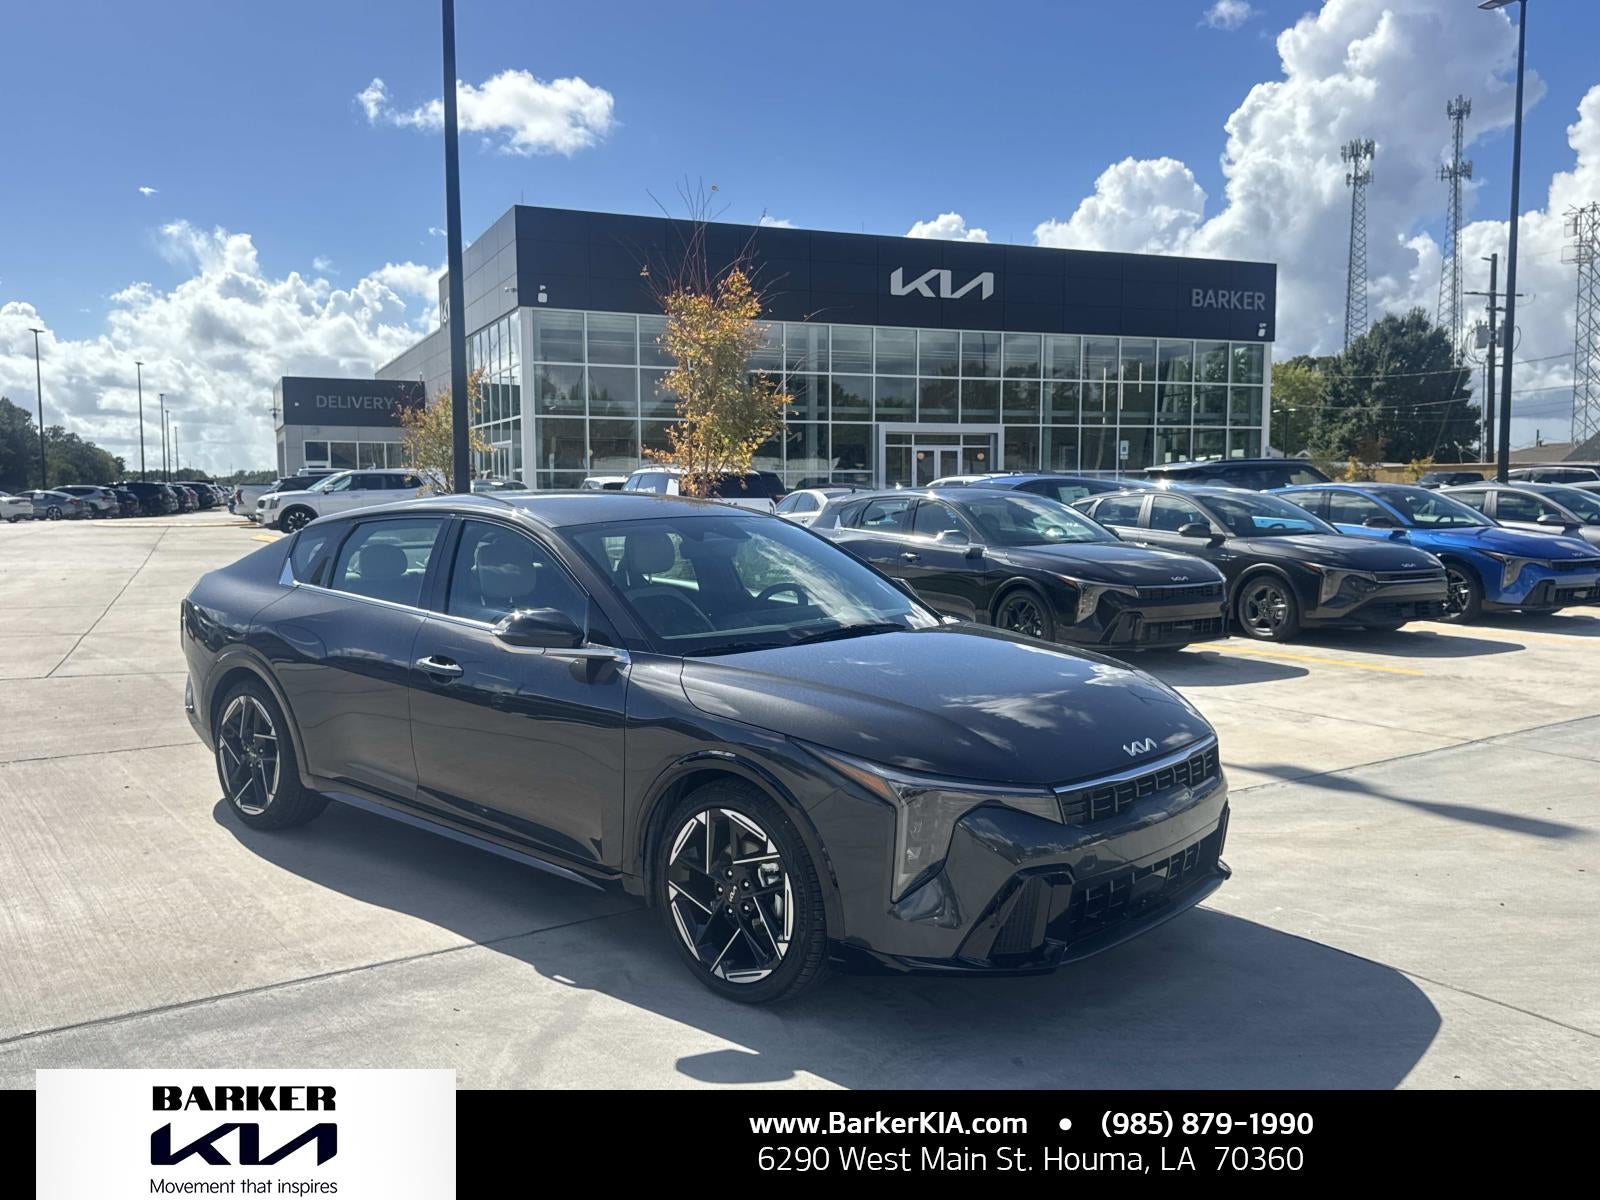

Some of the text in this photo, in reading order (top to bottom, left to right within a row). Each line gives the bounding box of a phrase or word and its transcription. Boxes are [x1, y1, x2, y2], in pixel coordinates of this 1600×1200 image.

[890, 266, 994, 300] KIA
[1192, 288, 1266, 311] BARKER
[316, 395, 395, 410] DELIVERY
[1122, 737, 1158, 756] KIA
